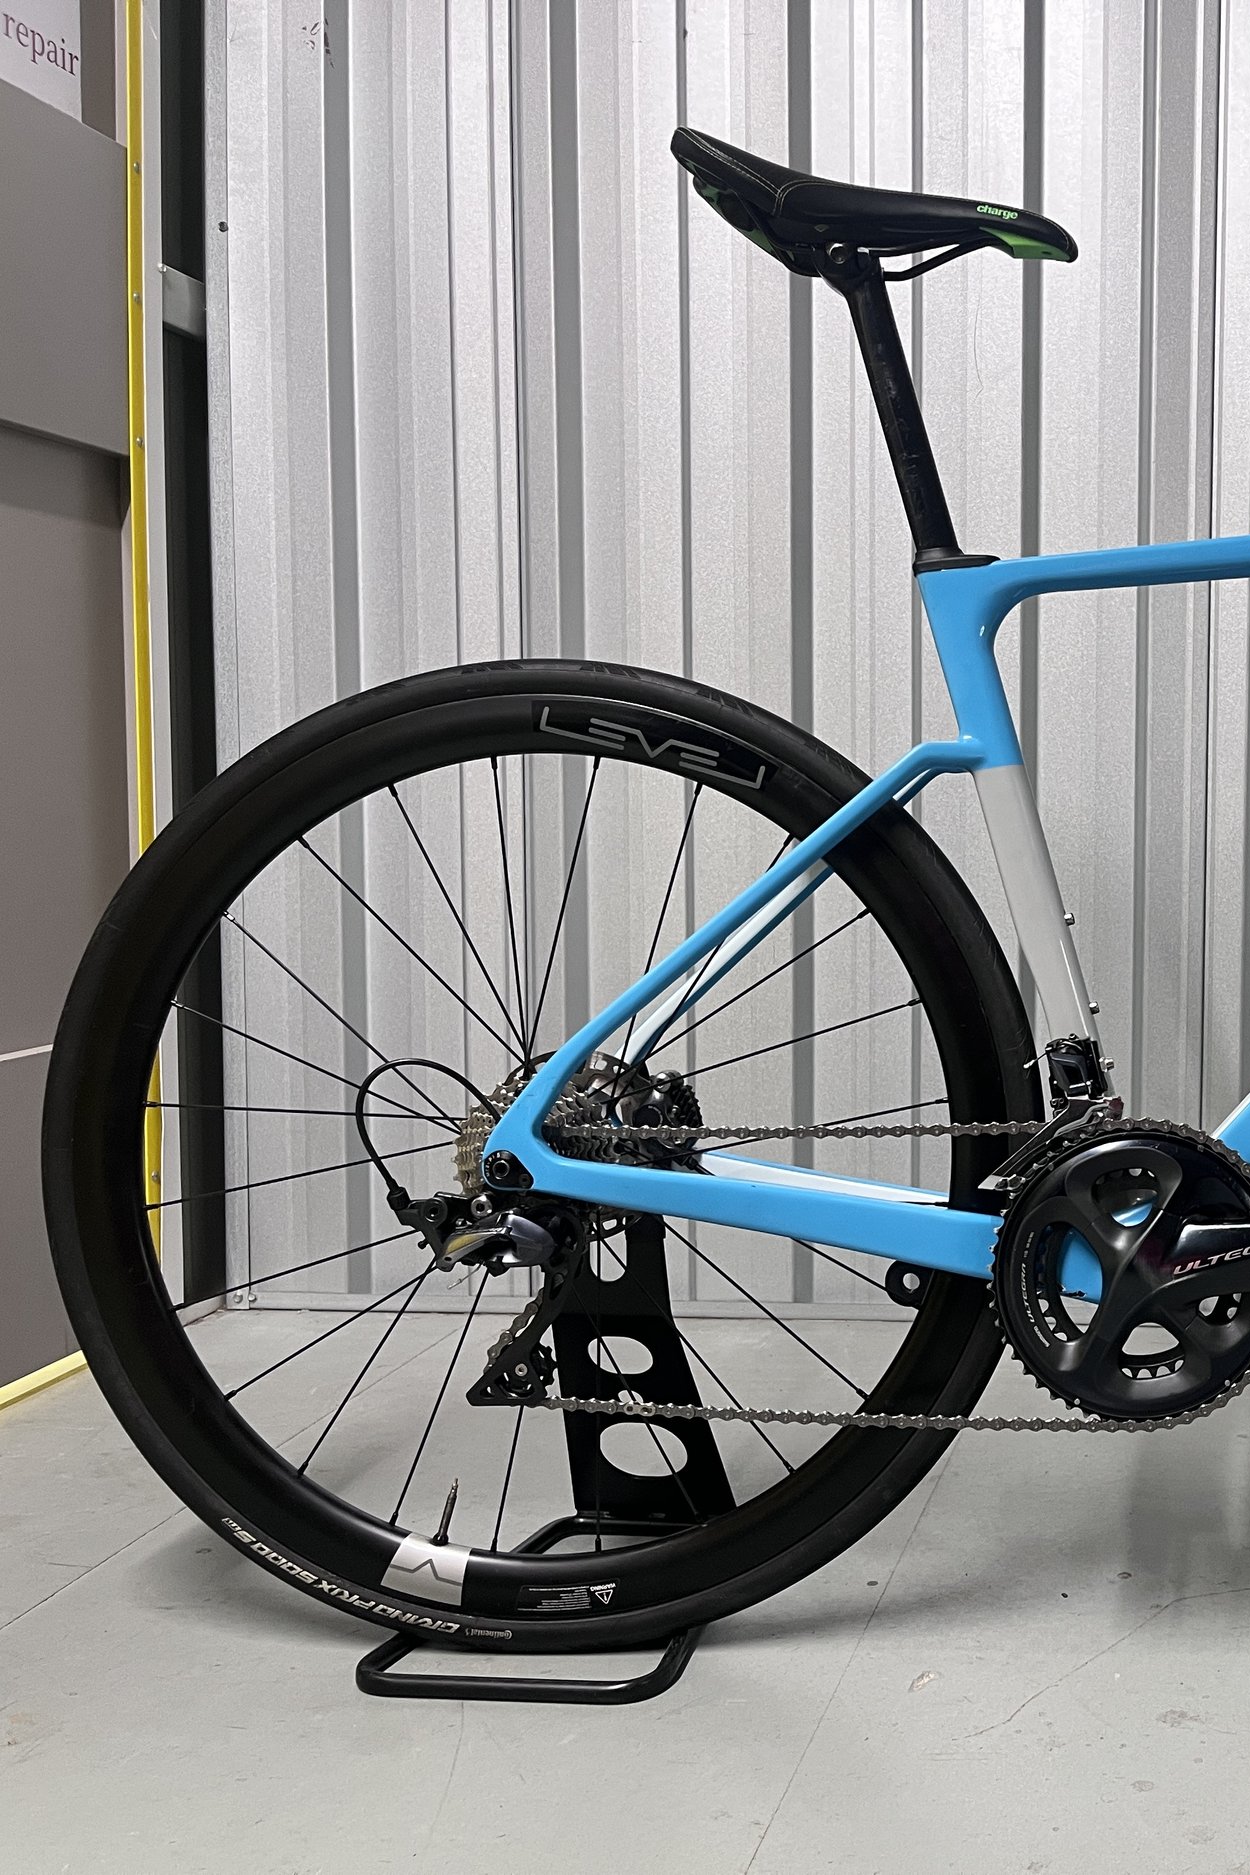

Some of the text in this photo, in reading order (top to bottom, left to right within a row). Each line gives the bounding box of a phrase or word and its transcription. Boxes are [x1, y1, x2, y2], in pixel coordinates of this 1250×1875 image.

[3, 13, 79, 76] repair
[976, 204, 1018, 220] charge
[1021, 1263, 1036, 1323] ULTEGRA
[250, 1542, 319, 1584] 5000
[313, 1580, 377, 1610] PRIX
[372, 1604, 461, 1634] GRAND
